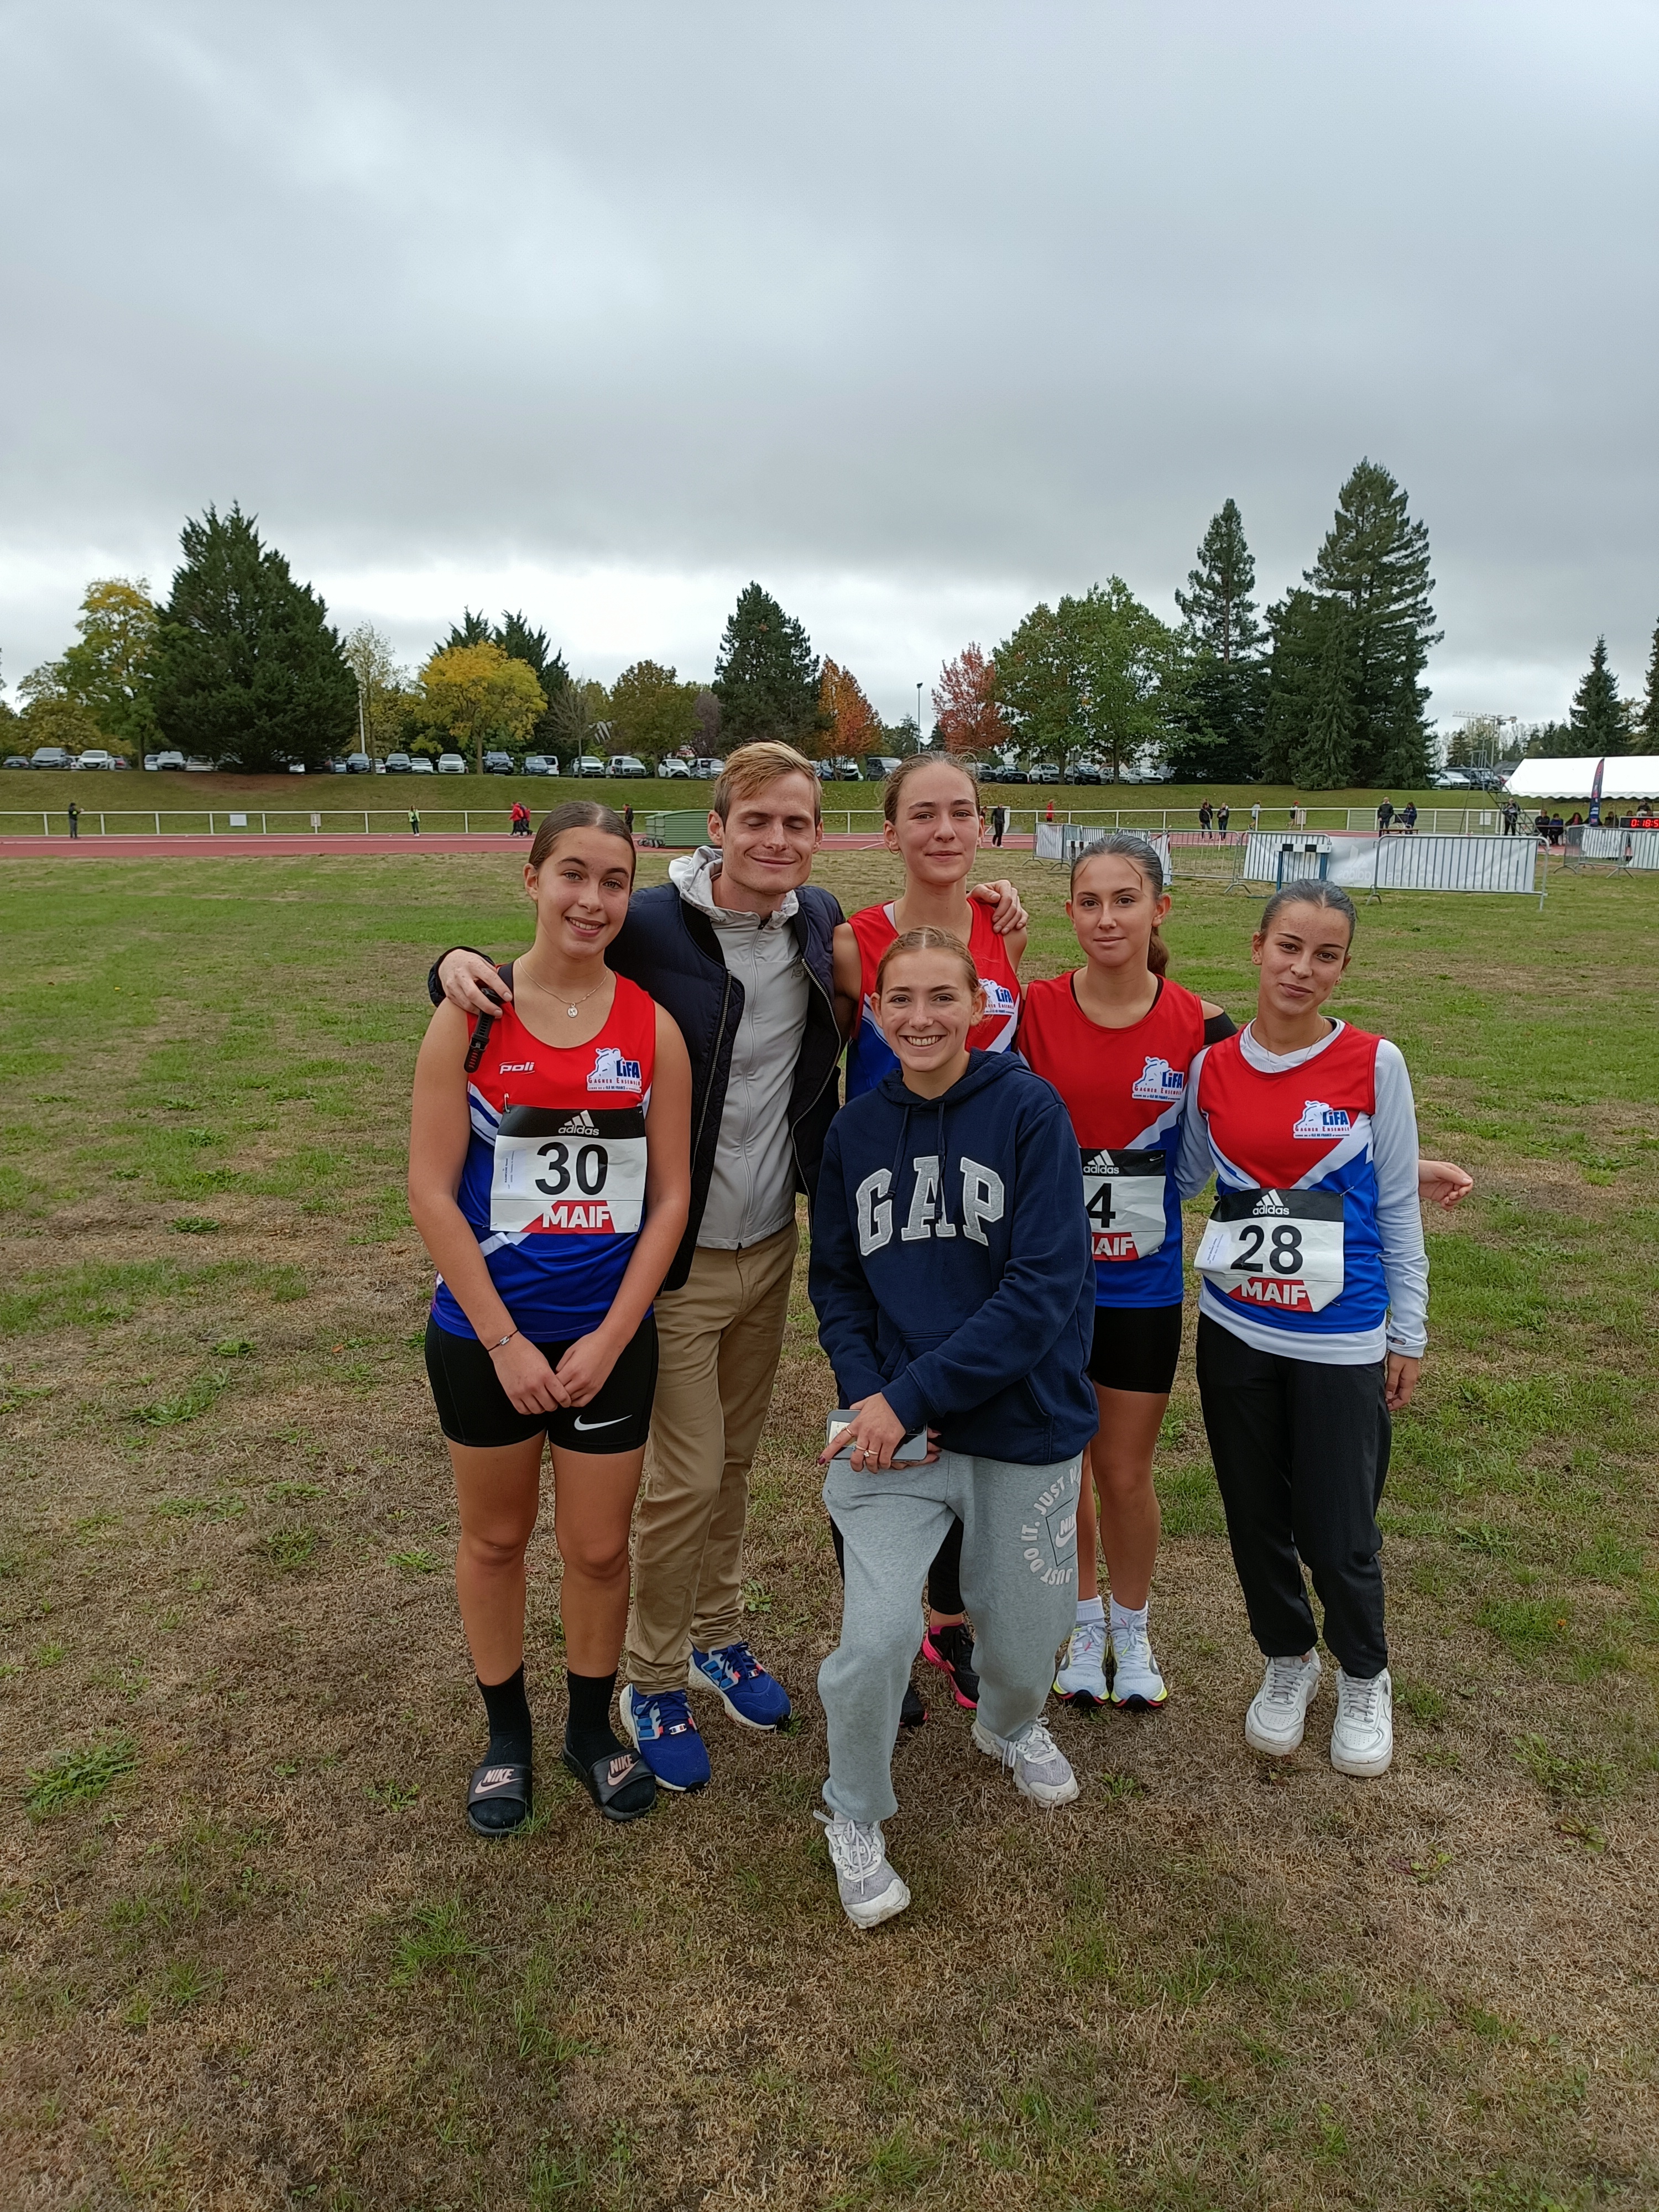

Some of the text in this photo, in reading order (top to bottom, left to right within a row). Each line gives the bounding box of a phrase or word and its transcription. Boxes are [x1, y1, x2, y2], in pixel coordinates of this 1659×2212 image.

[499, 1062, 535, 1074] poli
[558, 1125, 599, 1136] adidas
[535, 1142, 608, 1195] 30
[1083, 1165, 1120, 1175] adidas
[855, 1155, 1005, 1256] GAP
[1086, 1183, 1116, 1228] 4
[1252, 1205, 1290, 1215] adidas
[542, 1206, 610, 1228] MAIF
[1092, 1237, 1134, 1256] AIF
[1230, 1224, 1303, 1275] 28
[1241, 1281, 1307, 1305] MAIF
[1021, 1475, 1073, 1585] JUST DO IT. JUST
[610, 1754, 633, 1775] NIKE
[482, 1768, 515, 1783] NIKE
